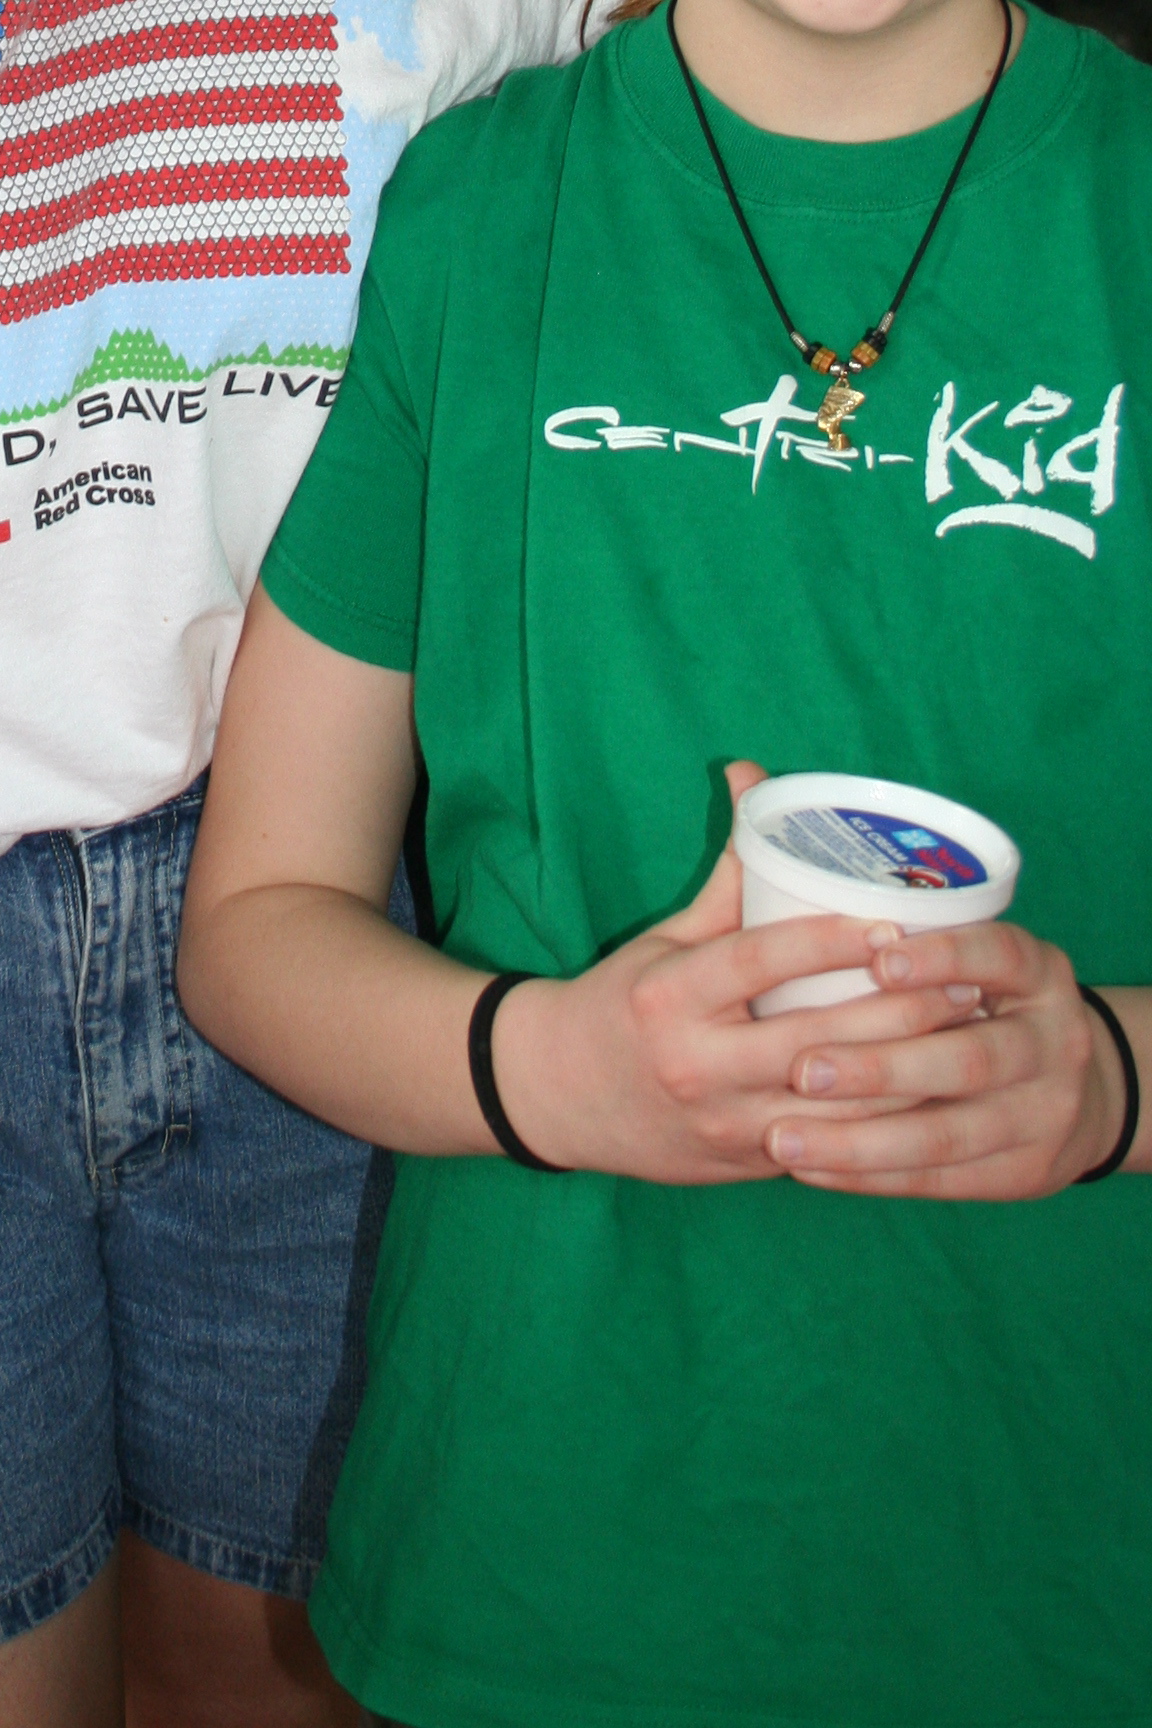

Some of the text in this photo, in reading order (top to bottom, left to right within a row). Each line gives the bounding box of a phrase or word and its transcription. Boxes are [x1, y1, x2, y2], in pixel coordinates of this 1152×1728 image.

[76, 385, 208, 429] SAVE
[34, 461, 152, 510] American
[34, 485, 155, 530] Red Cross
